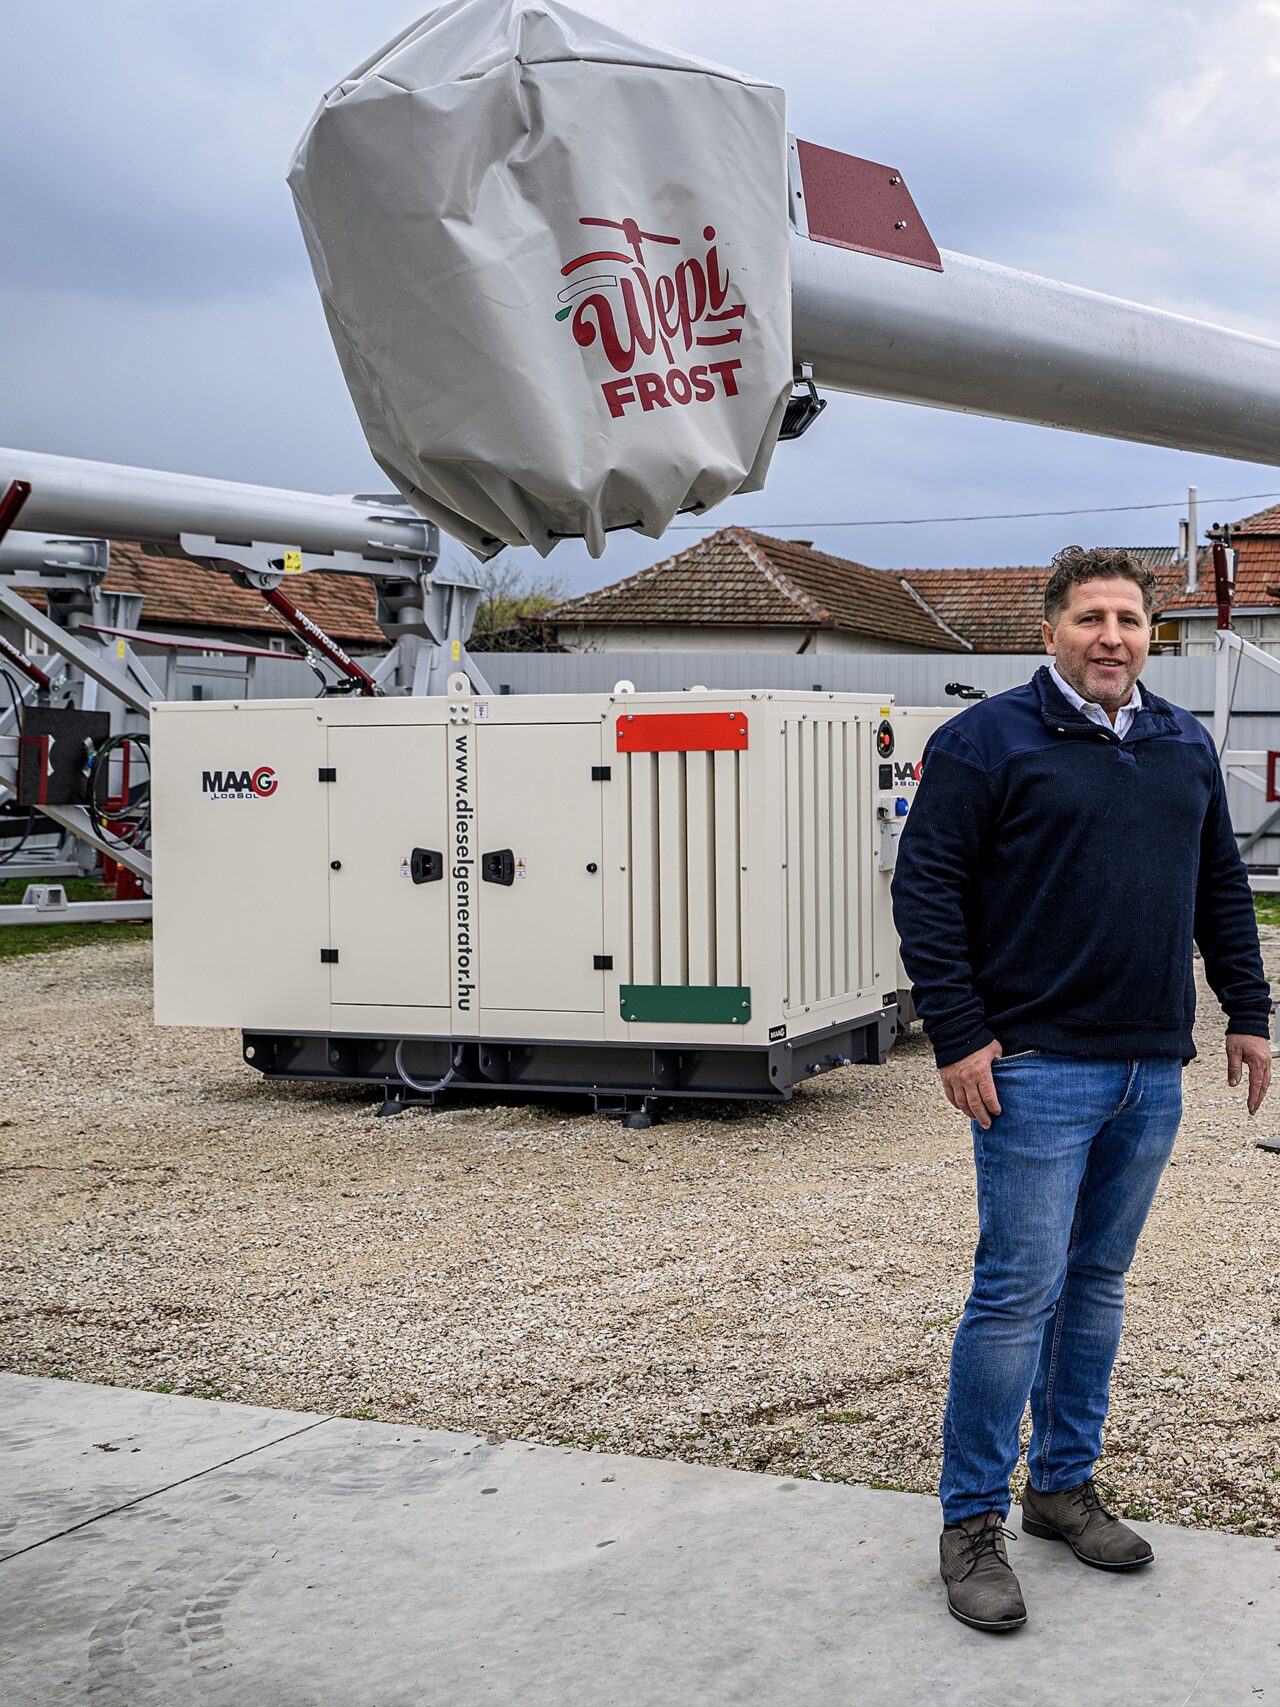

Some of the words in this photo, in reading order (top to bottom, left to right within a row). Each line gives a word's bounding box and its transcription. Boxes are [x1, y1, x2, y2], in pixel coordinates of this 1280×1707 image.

[573, 226, 730, 373] Wepi
[601, 358, 743, 418] FROST
[452, 734, 475, 1011] www.dieselgenerator.hu
